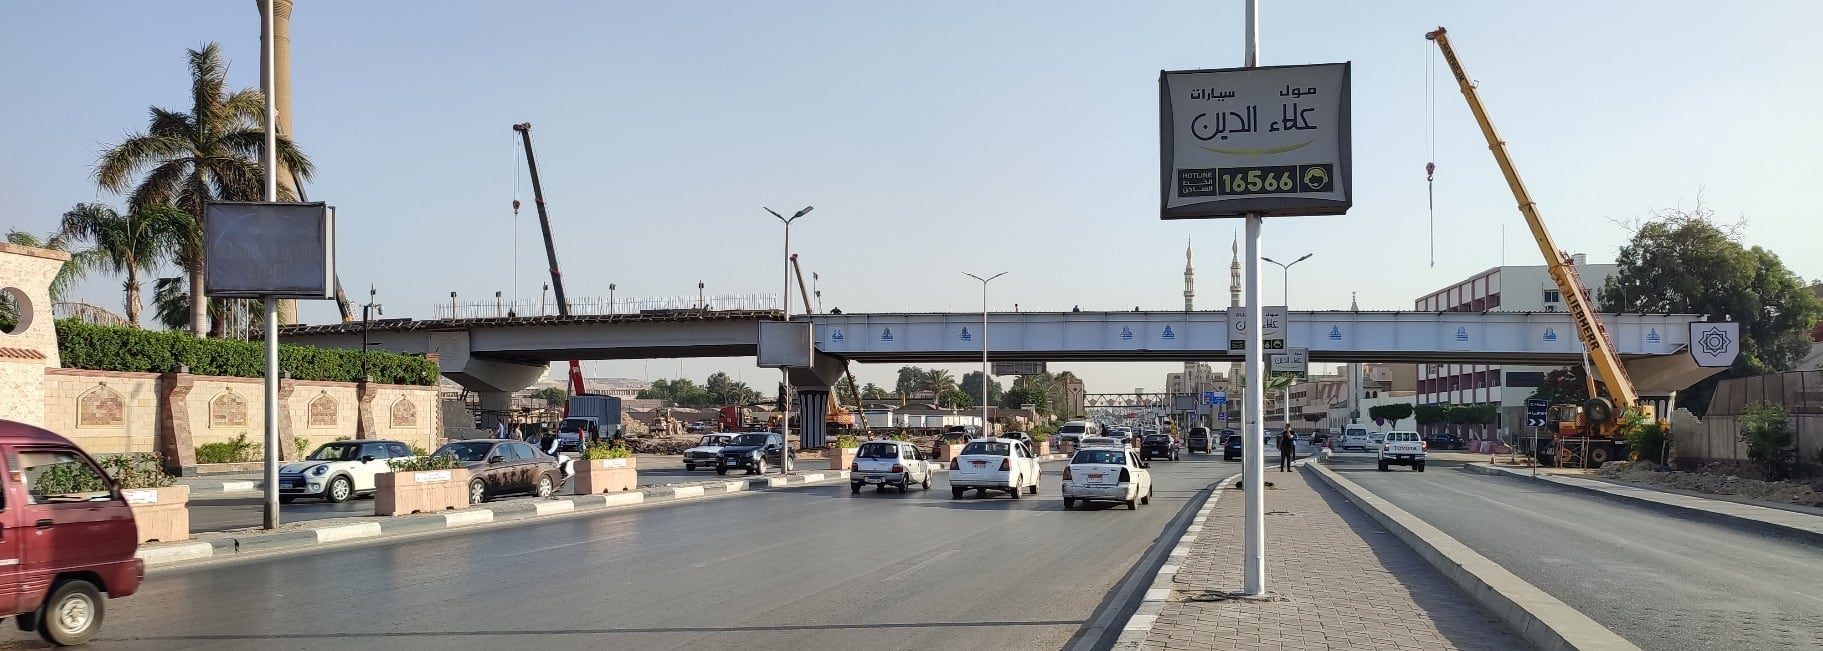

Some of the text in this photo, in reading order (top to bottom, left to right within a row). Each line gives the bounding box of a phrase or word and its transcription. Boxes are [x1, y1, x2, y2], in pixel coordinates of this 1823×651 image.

[1190, 85, 1316, 101] مول سيارات
[1191, 102, 1318, 141] علاء الدين
[1222, 170, 1293, 193] 16566
[1566, 292, 1600, 352] LIEBHERR
